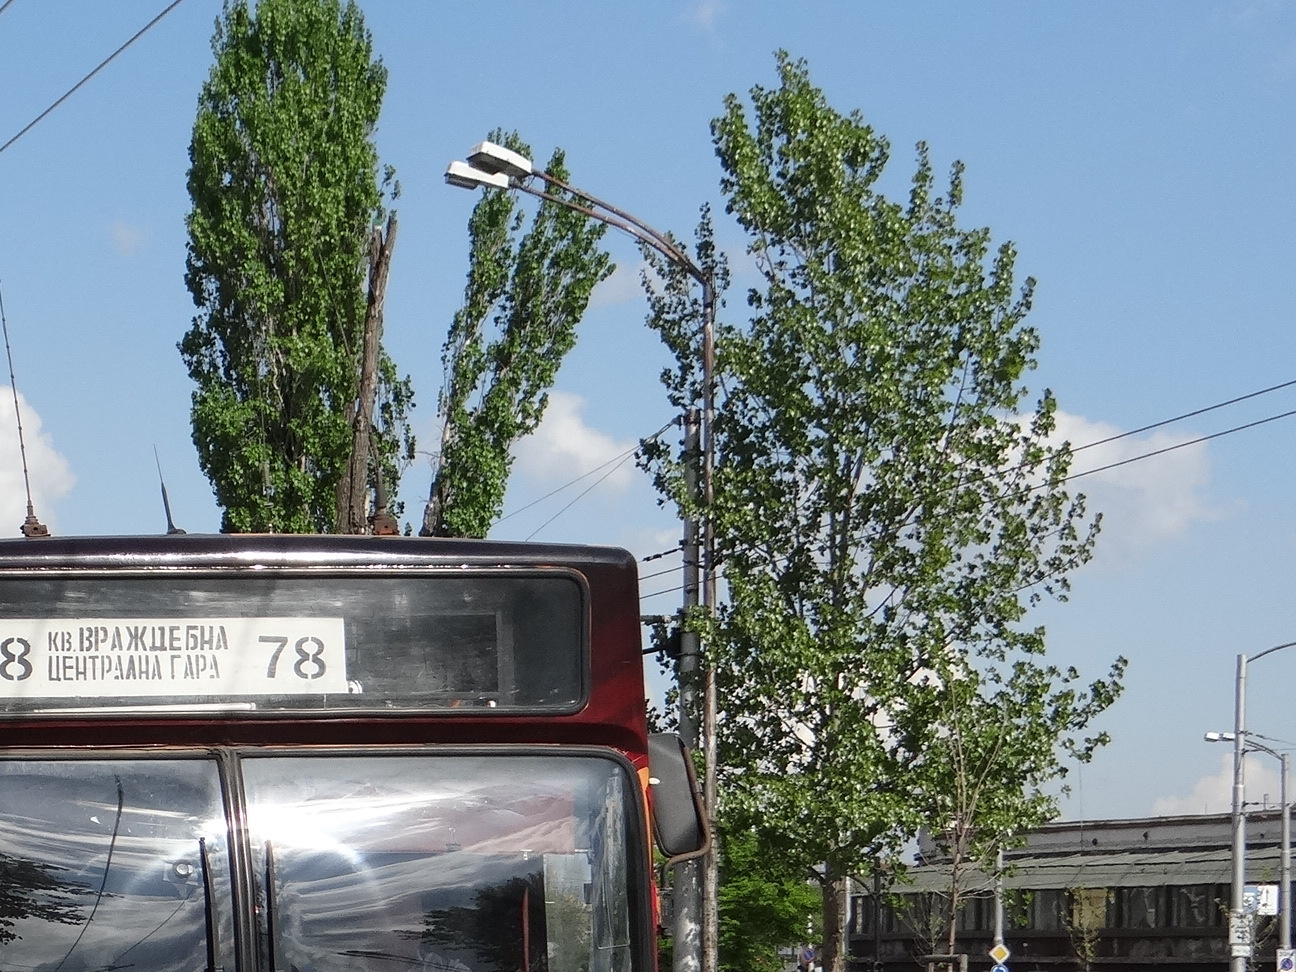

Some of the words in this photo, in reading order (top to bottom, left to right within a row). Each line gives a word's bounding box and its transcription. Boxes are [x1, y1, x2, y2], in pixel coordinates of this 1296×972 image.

[48, 655, 162, 681] ЦЕНТРАЛНА
[170, 654, 220, 680] ГАРА
[258, 635, 326, 680] 78
